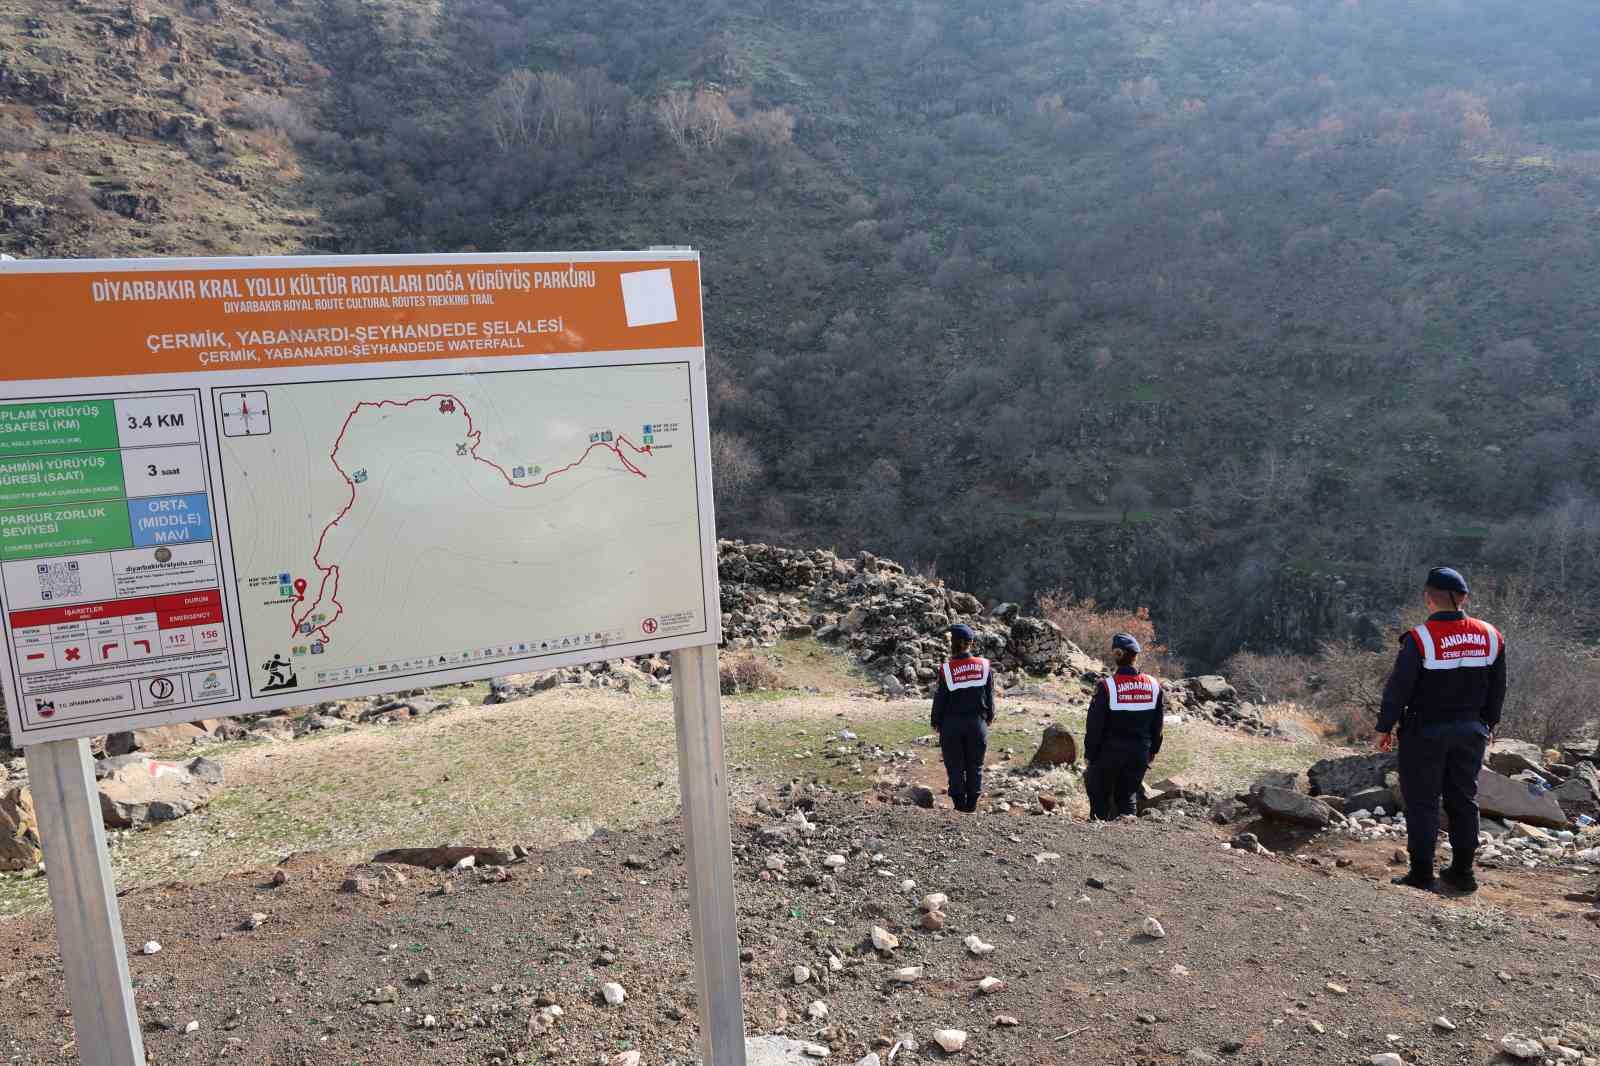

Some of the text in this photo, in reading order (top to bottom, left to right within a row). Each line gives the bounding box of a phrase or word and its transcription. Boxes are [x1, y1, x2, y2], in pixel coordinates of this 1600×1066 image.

[92, 278, 196, 301] DİYARBAKIR
[199, 278, 242, 299] KRAL
[245, 276, 286, 297] YOLU
[289, 273, 348, 296] KÜLTÜR
[351, 273, 423, 295] ROTALARI
[426, 270, 464, 292] DOĞA
[467, 268, 530, 293] YÜRÜYÜŞ
[283, 299, 314, 312] ROYAL
[314, 298, 345, 311] ROUTE
[346, 296, 391, 309] CULTURAL
[391, 295, 426, 308] ROUTES
[426, 293, 469, 307] TREKKING
[471, 293, 495, 305] TRAIL
[146, 317, 564, 353] ÇERMİK, YABANARDI-ŞEYHANDEDE ŞELALESİ
[198, 337, 525, 366] ÇERMİK, YABANARDI-ŞEYHANDEDE WATERFALL
[0, 404, 100, 421] PLAM YÜRÜYÜŞ
[0, 419, 81, 433] ESAFESİ (KM)
[127, 413, 185, 430] 3.4 KM
[0, 455, 105, 473] AHMİNİ YÜRÜYÜŞ
[147, 464, 181, 477] 3 saat
[0, 470, 84, 486] ÜRESİ (SAAT)
[148, 498, 188, 513] ORTA
[0, 507, 105, 526] PARKUR ZORLUK
[138, 512, 201, 531] (MIDDLE)
[2, 522, 59, 537] SEVİYESİ
[154, 527, 190, 543] MAVİ
[169, 611, 211, 623] EMERGENCY
[169, 634, 185, 643] 112
[201, 630, 218, 640] 156
[1440, 633, 1487, 649] JANDARMA
[952, 663, 983, 676] JANDARMA
[1117, 681, 1153, 693] JANDARMA
